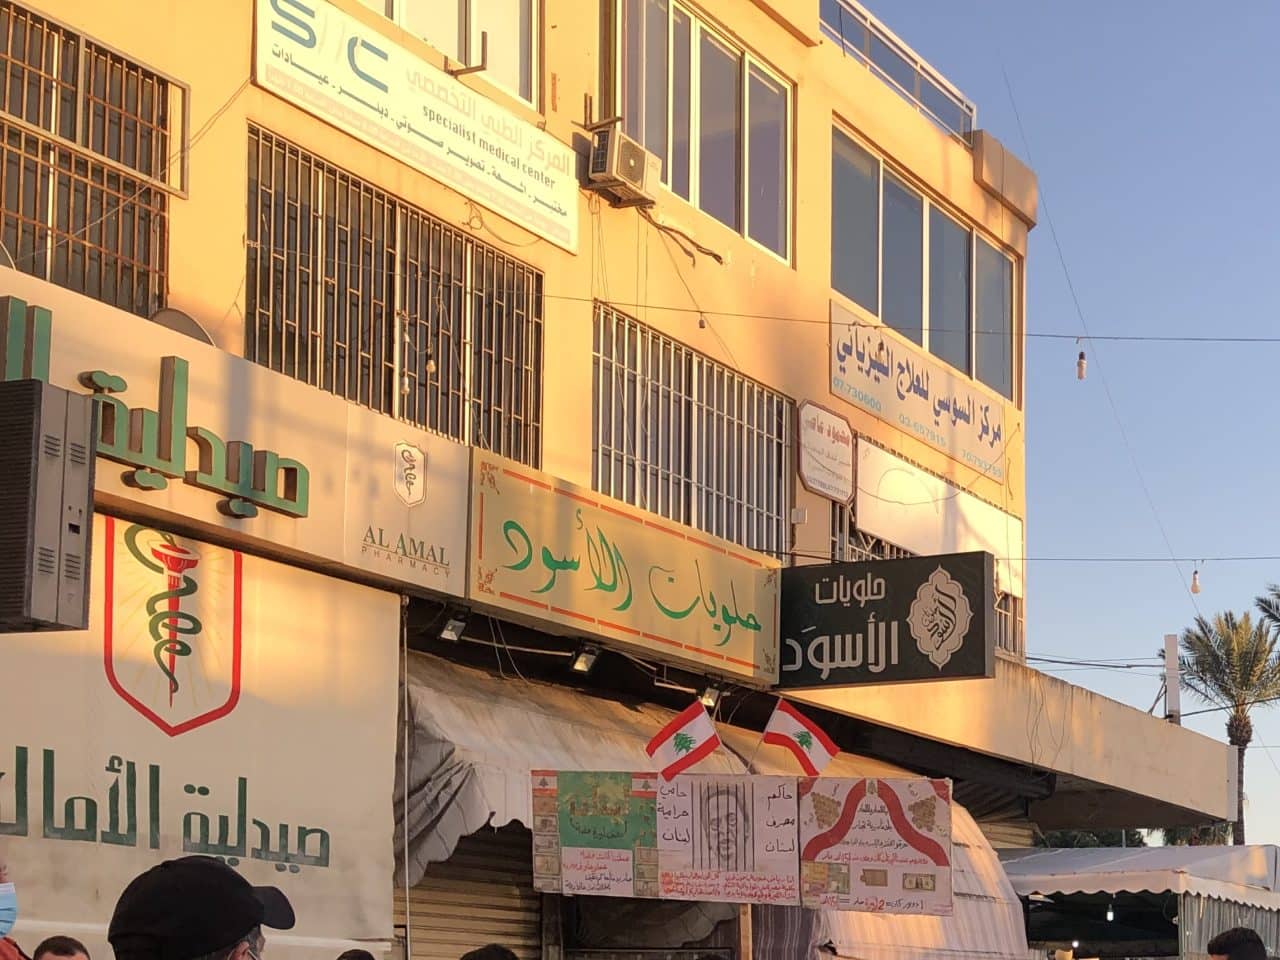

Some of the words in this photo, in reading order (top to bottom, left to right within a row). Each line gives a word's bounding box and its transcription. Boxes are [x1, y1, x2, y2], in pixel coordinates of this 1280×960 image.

[423, 105, 477, 145] specialist
[479, 137, 520, 170] medical
[522, 163, 556, 190] center
[481, 113, 522, 149] الطبي
[528, 139, 569, 176] المركز
[896, 356, 930, 401] للعلاج
[933, 392, 975, 427] السوسي
[977, 404, 1001, 448] مركز
[78, 355, 310, 519] صيدلية
[361, 546, 451, 579] PHARMACY
[363, 525, 390, 549] AL
[393, 532, 450, 567] AMAL
[501, 508, 633, 612] الأسود
[648, 559, 762, 647] حلويات
[815, 572, 886, 609] حلويات
[767, 783, 793, 812] حاكم
[182, 776, 331, 874] صيدلية
[662, 826, 691, 844] لبنان
[764, 838, 795, 853] لبنان
